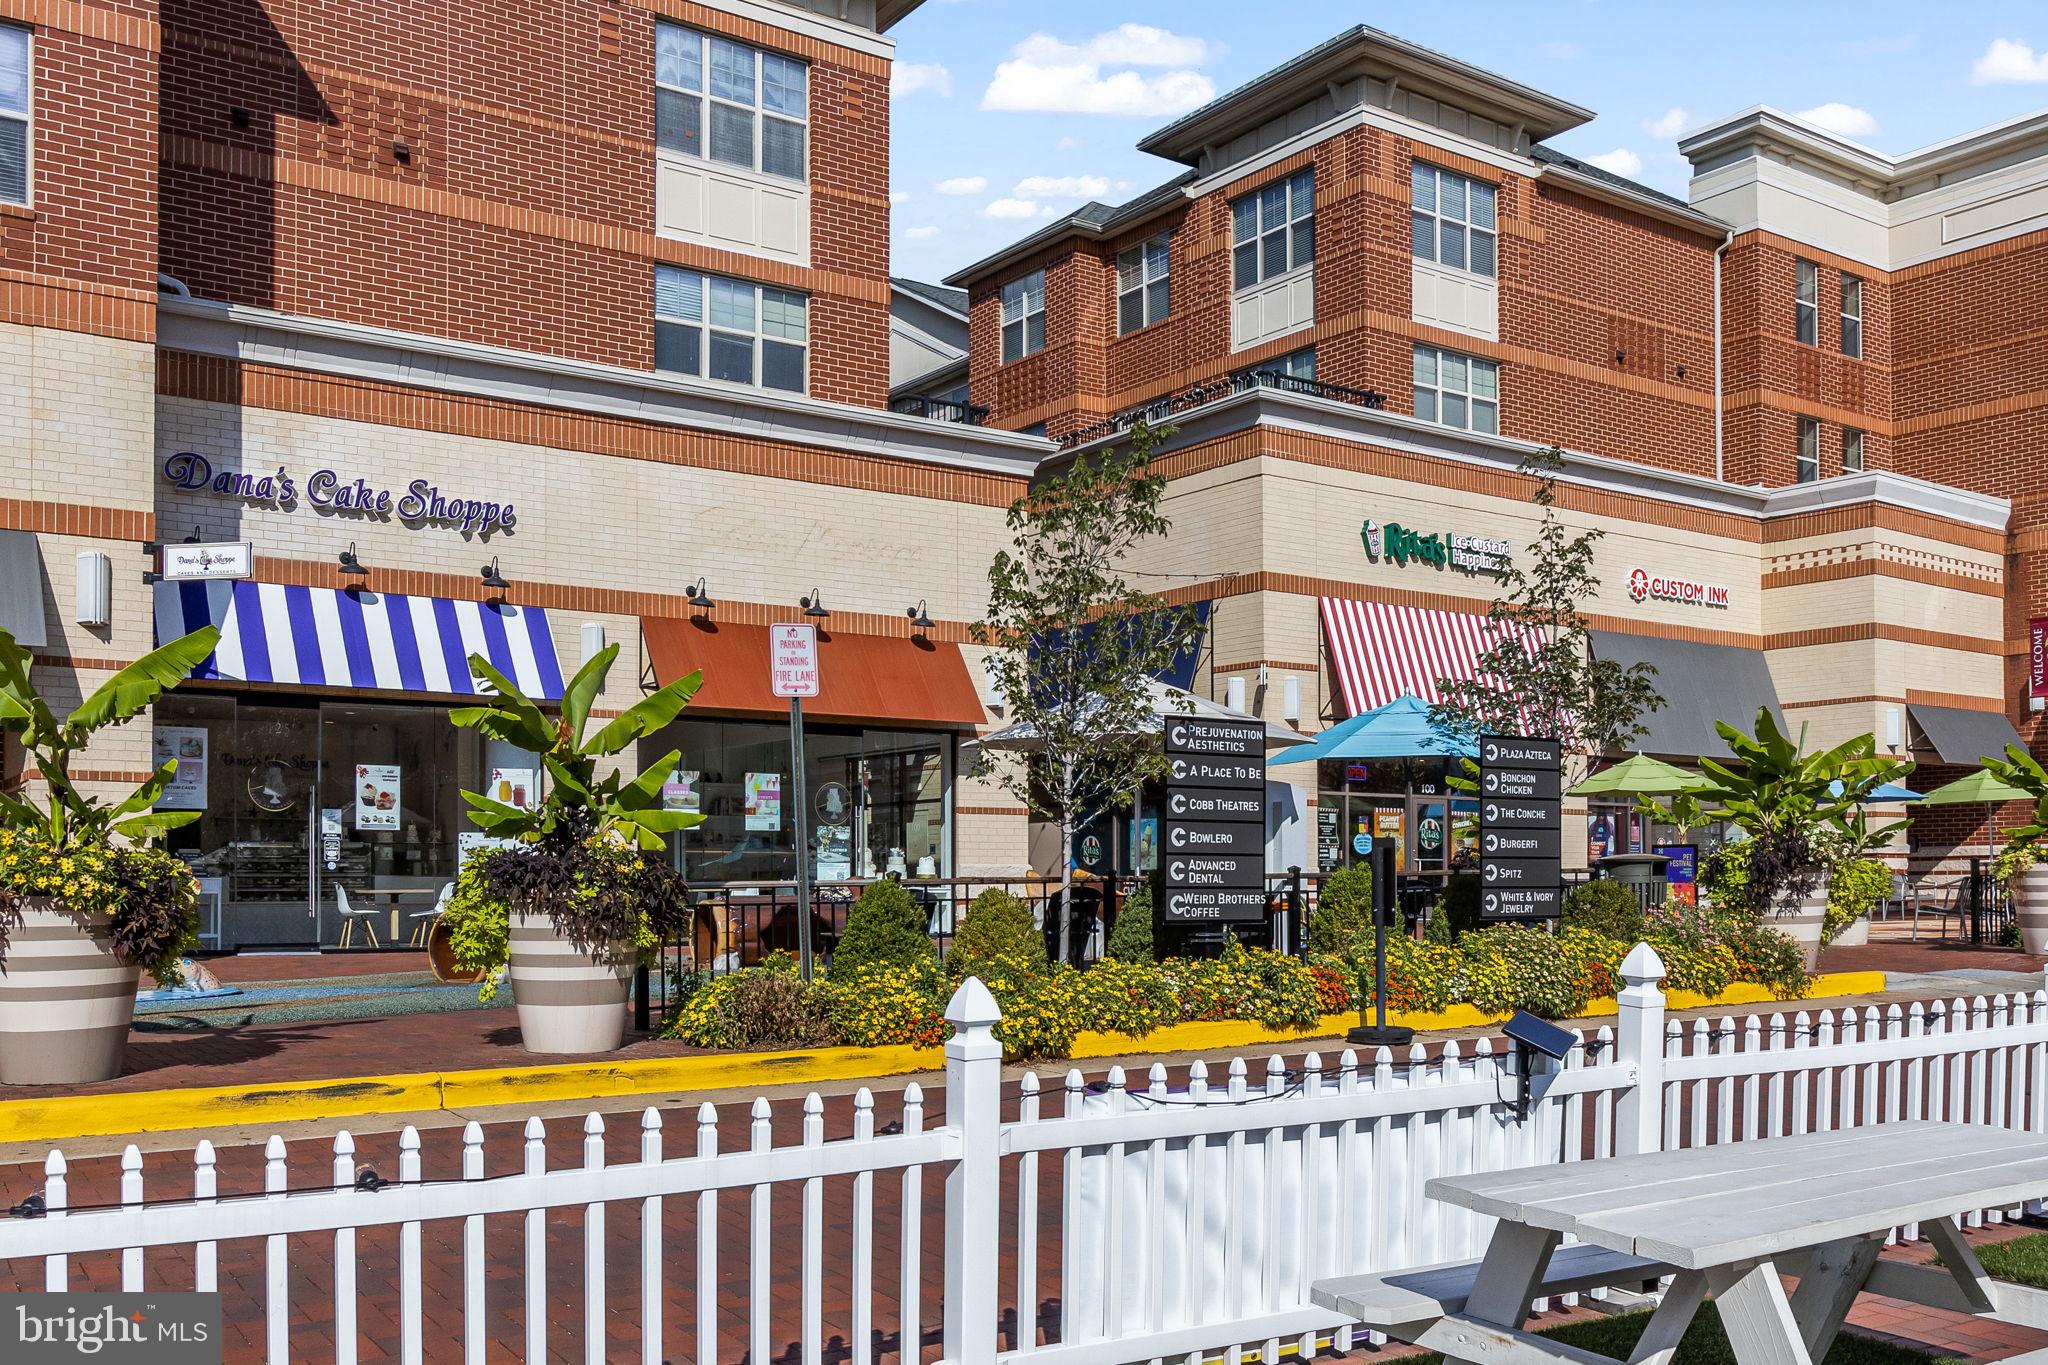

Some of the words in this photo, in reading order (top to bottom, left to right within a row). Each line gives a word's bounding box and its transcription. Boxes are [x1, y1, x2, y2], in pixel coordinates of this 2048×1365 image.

[163, 451, 296, 501] Dana's
[306, 469, 391, 513] Cake
[396, 478, 515, 533] Shoppe
[1383, 522, 1446, 566] Rita's
[176, 554, 199, 565] Dana's
[1651, 577, 1704, 601] CUSTOM
[1708, 586, 1729, 604] INK
[786, 629, 798, 639] NO
[779, 639, 807, 649] PARKING
[779, 656, 809, 666] STANDING
[2033, 628, 2044, 687] WELCOME
[775, 670, 792, 682] FIRE
[795, 670, 816, 682] LANE
[1188, 724, 1263, 740] PREJUVENATION
[1187, 738, 1245, 752] AESTHETICS
[1500, 748, 1524, 760] PLAZA
[1525, 749, 1552, 761] AZTECA
[1190, 765, 1198, 777] A
[1201, 765, 1232, 778] PLACE
[1234, 767, 1246, 779] TO
[1248, 767, 1262, 780] BE
[1500, 772, 1536, 784] BONCHON
[1421, 784, 1435, 794] 100
[1500, 784, 1533, 795] CHICKEN
[1189, 798, 1214, 811] COBB
[1215, 799, 1260, 812] THEATRES
[1500, 807, 1516, 819] THE
[1516, 808, 1546, 820] CONCHE
[1189, 832, 1233, 844] BOWLERO
[1421, 827, 1440, 840] Rita's
[1500, 838, 1538, 849] BURGERFI
[1083, 844, 1100, 856] Rita's
[1669, 859, 1693, 867] FESTIVAL
[1682, 853, 1693, 861] PET
[1188, 860, 1237, 871] ADVANCED
[1188, 872, 1224, 884] DENTAL
[1499, 868, 1522, 879] SPITZ
[1182, 892, 1215, 905] WEIRD
[1218, 893, 1266, 905] BROTHERS
[1500, 891, 1525, 902] WHITE
[1525, 891, 1532, 902] &
[1533, 891, 1554, 902] IVORY
[1183, 906, 1220, 918] COFFEE
[1500, 903, 1534, 914] JEWELRY
